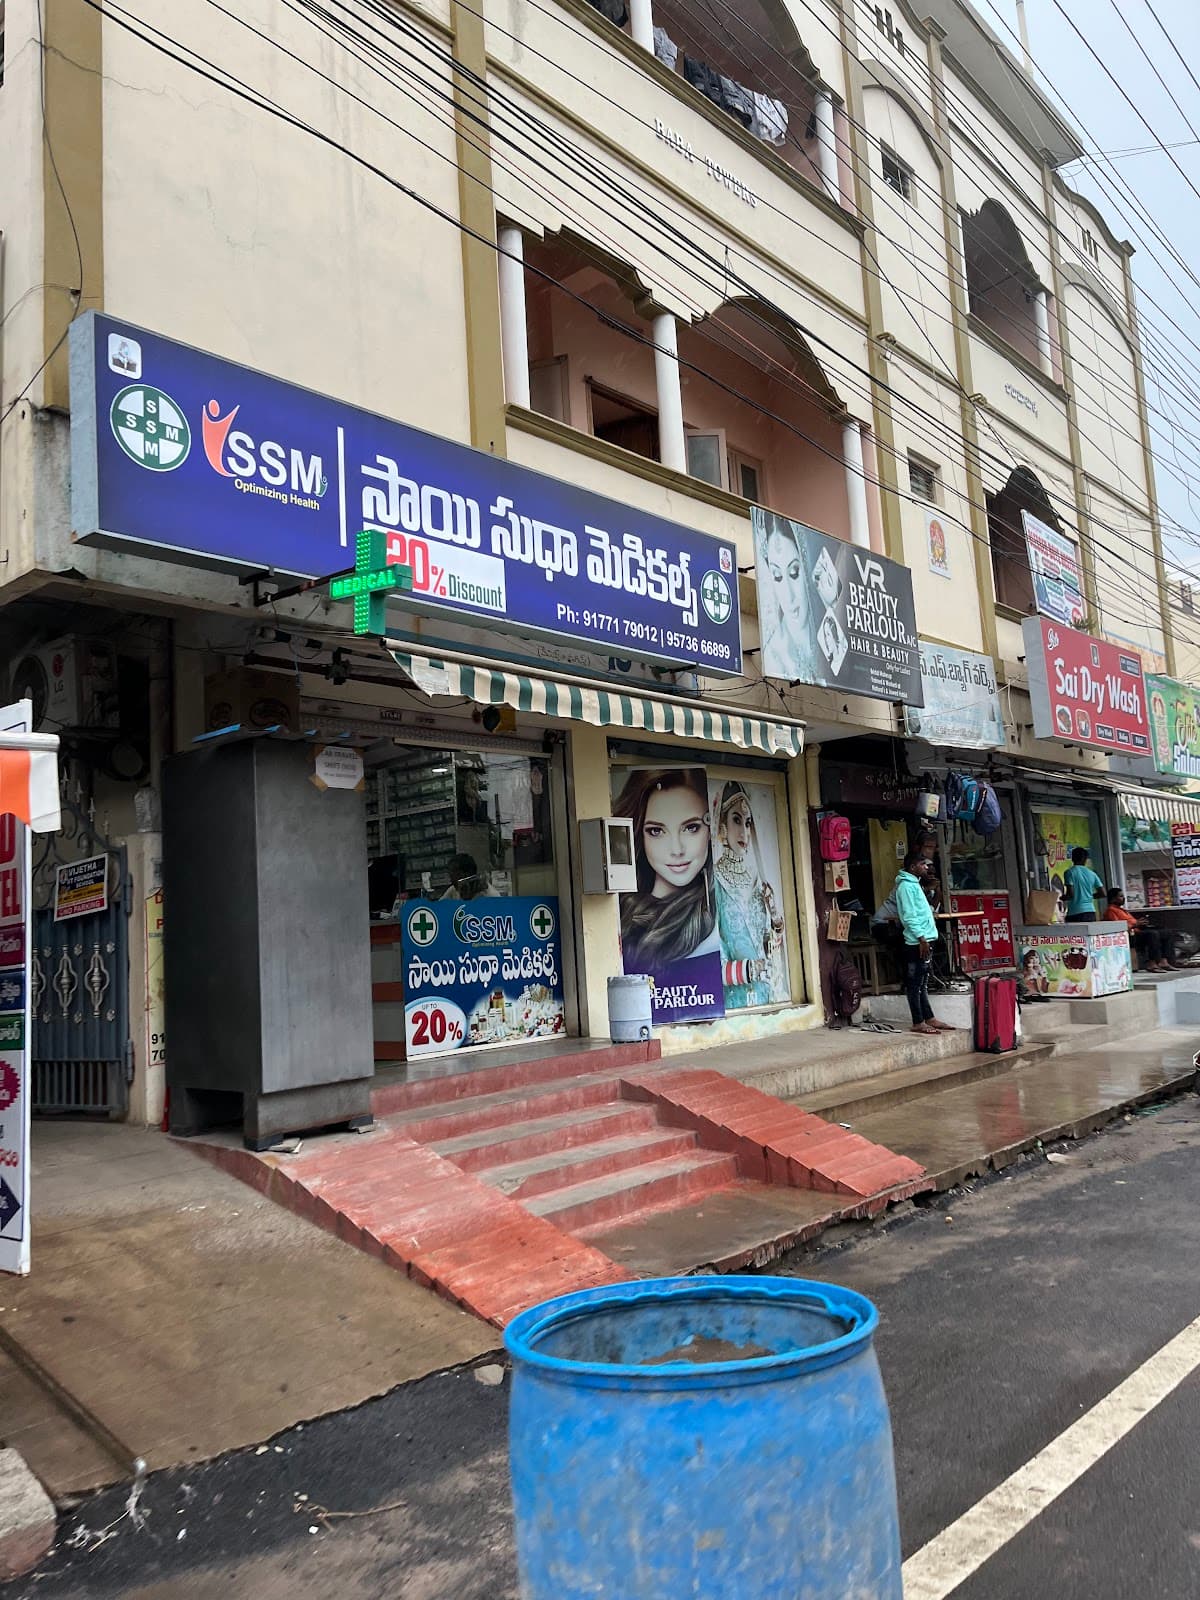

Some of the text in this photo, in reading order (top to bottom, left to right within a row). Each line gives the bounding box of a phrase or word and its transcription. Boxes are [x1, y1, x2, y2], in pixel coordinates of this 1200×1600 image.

[226, 430, 323, 495] SSM
[234, 478, 320, 511] Optimizing Health
[360, 454, 699, 628] సాయి సుధా మెడికల్స్
[332, 568, 397, 597] MEDICAL
[448, 573, 503, 609] Discount
[853, 553, 887, 593] VR
[848, 581, 898, 620] BEAUTY
[556, 603, 580, 625] Ph:
[582, 610, 620, 634] 91771
[622, 619, 658, 643] 79012
[667, 630, 699, 652] 95736
[700, 640, 731, 660] 66899
[845, 604, 907, 645] PARLOUR
[850, 635, 909, 665] HAIR & BEAUTY
[1054, 657, 1143, 724] Sai Dry Wash
[466, 915, 514, 944] SSM
[408, 942, 558, 989] సాయి సుధా మెడికల్స్
[654, 993, 716, 1010] PARLOUR
[411, 1008, 463, 1047] 20%
